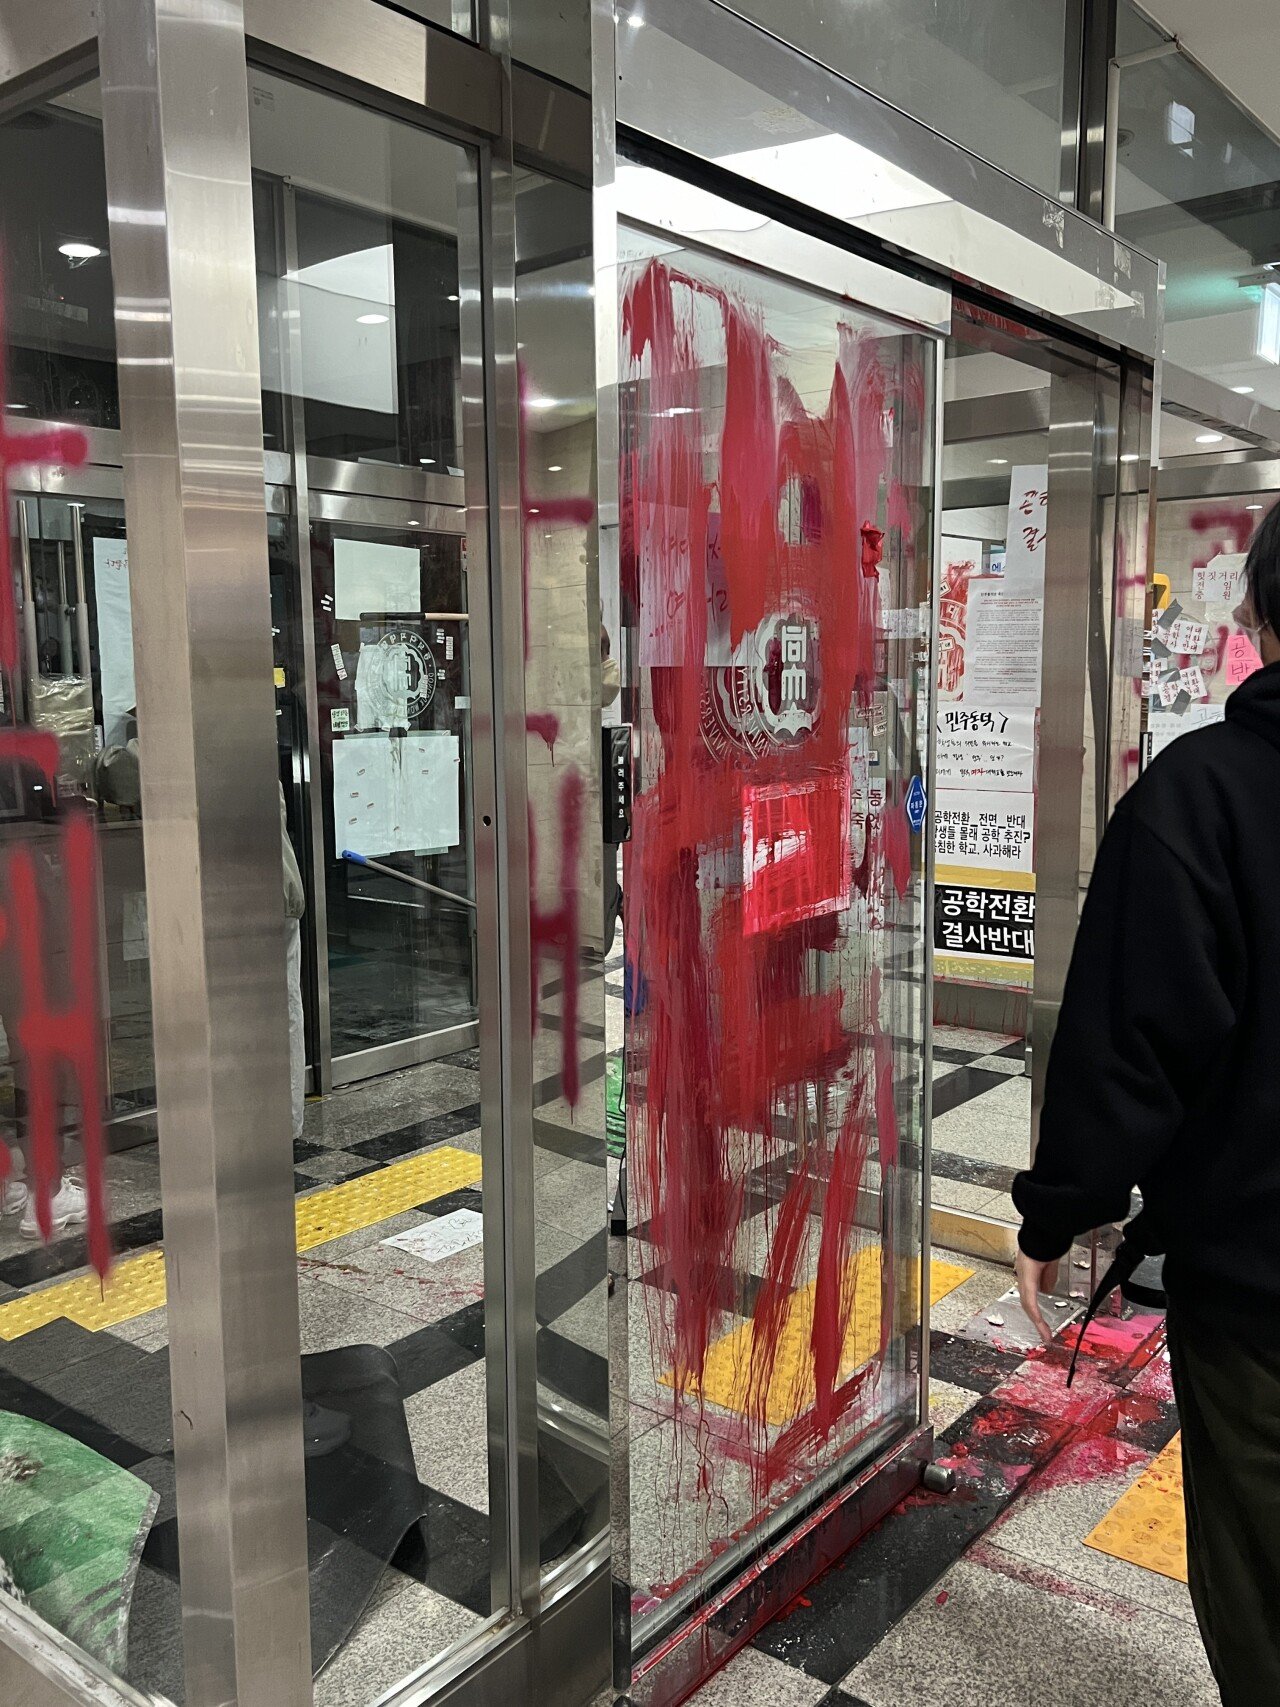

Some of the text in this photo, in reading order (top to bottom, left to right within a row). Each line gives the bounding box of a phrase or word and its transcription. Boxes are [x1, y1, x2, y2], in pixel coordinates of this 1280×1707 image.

[1023, 527, 1047, 552] 결
[960, 826, 978, 841] 몰래
[981, 828, 1000, 842] 공학
[1004, 830, 1031, 844] 추진?
[935, 840, 1021, 859] 침한 학교. 사과해라
[942, 889, 1035, 923] 공학전환
[942, 921, 1035, 956] 결사반대
